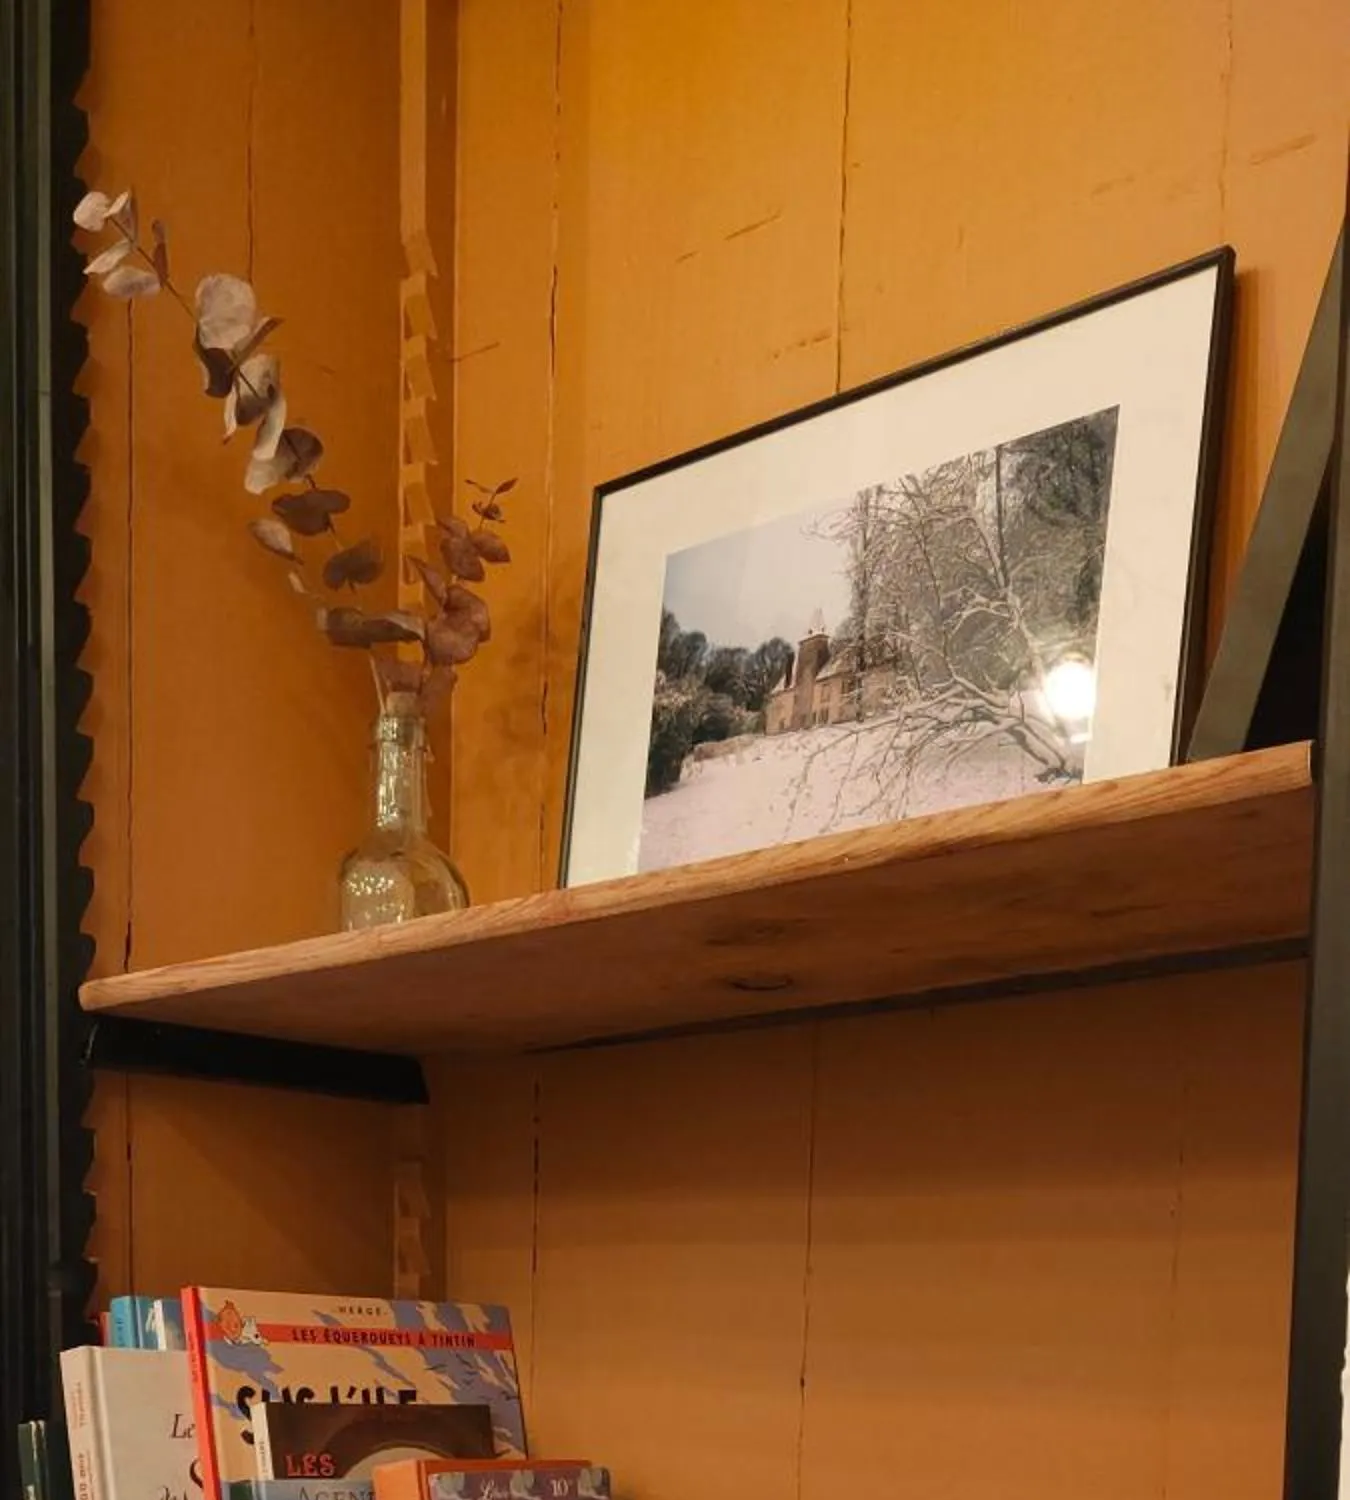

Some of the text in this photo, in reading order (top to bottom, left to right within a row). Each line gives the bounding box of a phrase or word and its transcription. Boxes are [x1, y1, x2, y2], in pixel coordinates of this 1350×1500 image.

[292, 1329, 316, 1343] LES
[432, 1335, 476, 1348] TINTIN
[285, 1453, 336, 1477] LES
